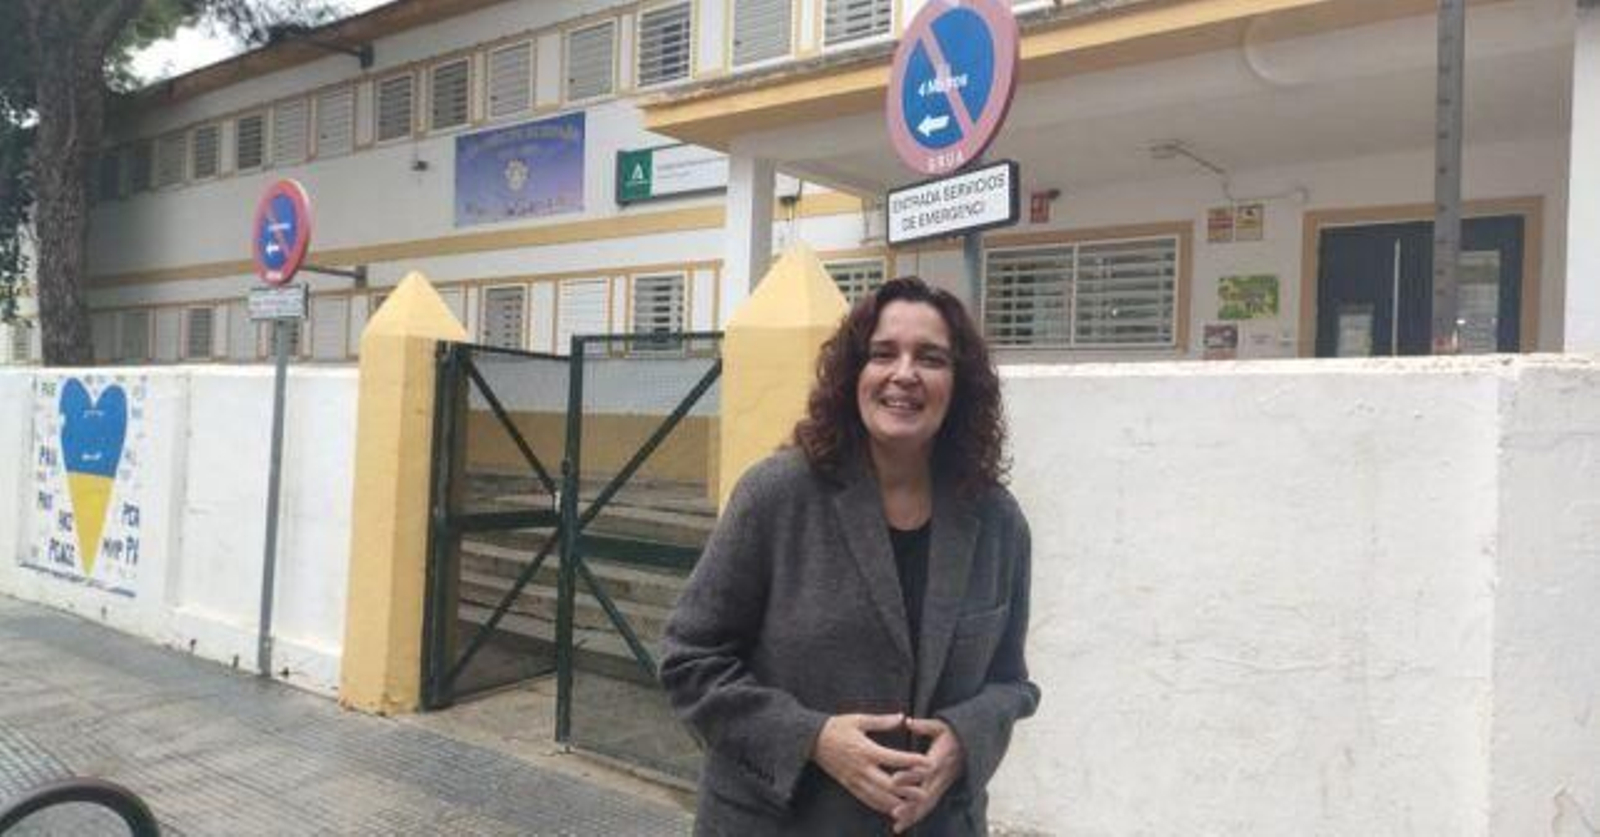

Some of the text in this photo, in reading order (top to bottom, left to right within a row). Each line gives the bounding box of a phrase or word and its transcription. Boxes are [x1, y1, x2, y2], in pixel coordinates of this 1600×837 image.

[892, 172, 1005, 214] ENTRADA SERVICIOS
[901, 215, 917, 232] DE
